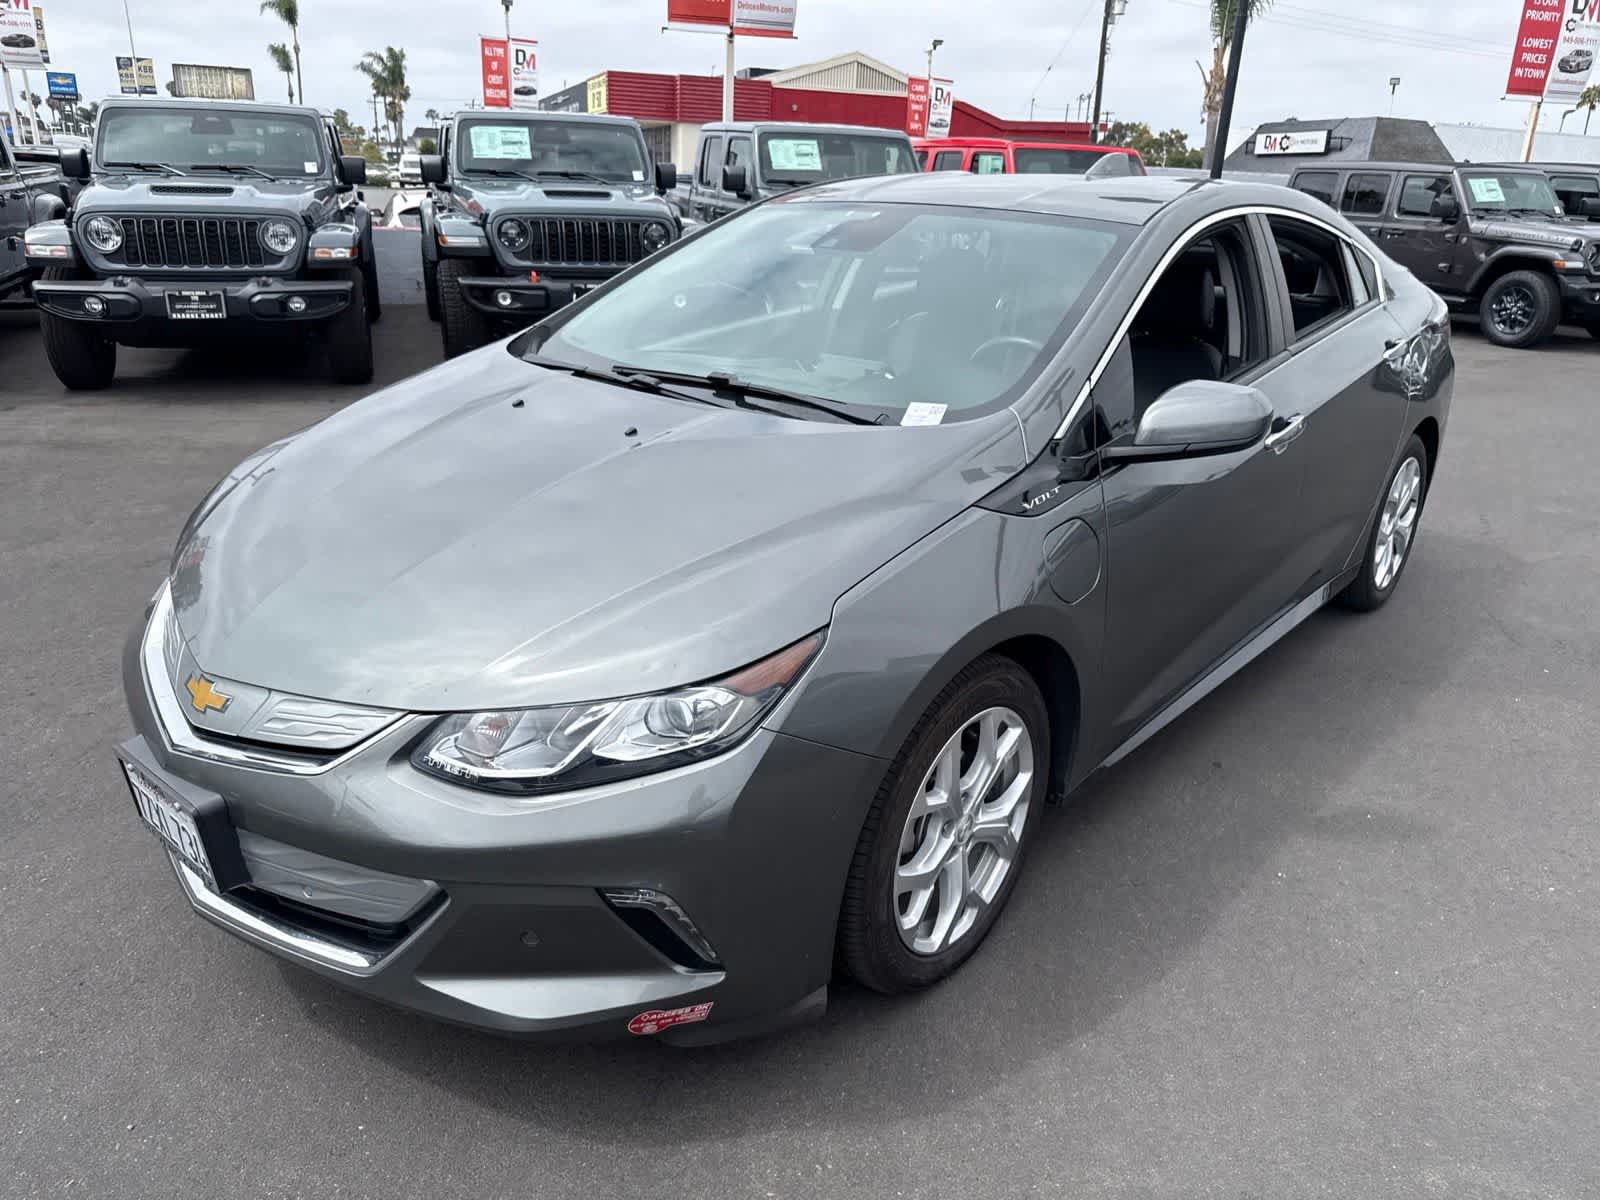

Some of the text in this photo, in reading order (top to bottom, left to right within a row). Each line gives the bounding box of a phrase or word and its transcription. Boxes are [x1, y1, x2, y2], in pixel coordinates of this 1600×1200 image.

[1526, 9, 1561, 22] PRIORITY
[1522, 37, 1554, 49] LOWEST
[1521, 52, 1548, 64] PRICES
[1514, 67, 1546, 79] IN TOWN
[1022, 485, 1062, 510] VOLT
[650, 1004, 709, 1020] ACCESS OK
